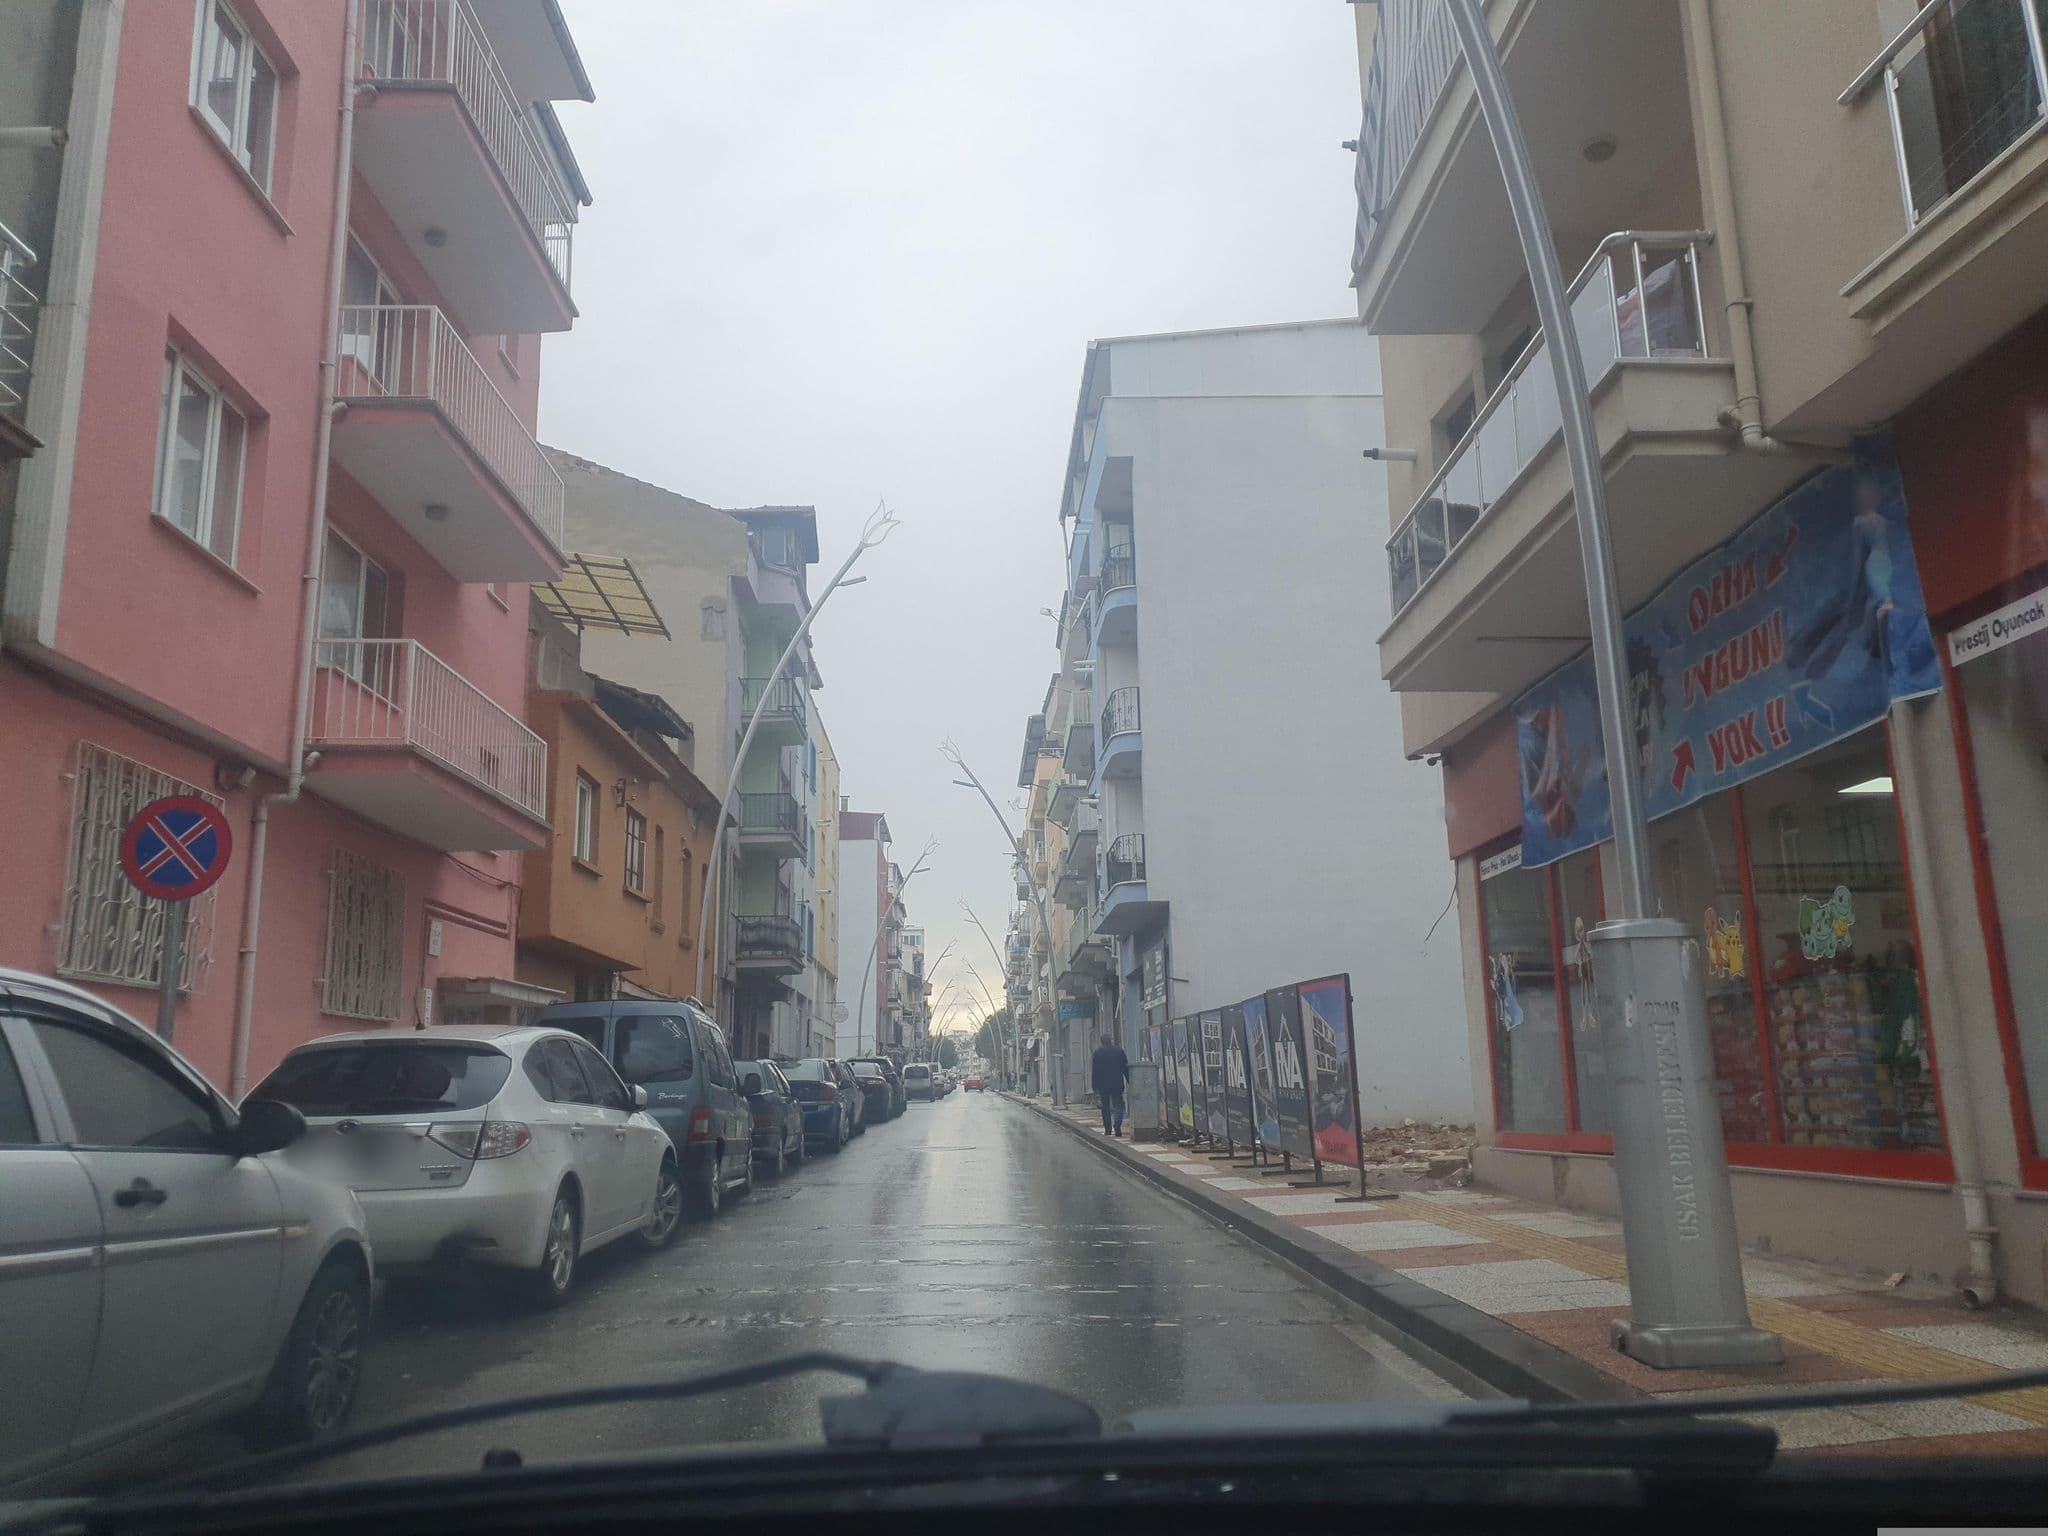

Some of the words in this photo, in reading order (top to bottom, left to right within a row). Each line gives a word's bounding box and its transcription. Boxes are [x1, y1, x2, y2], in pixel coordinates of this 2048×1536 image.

[1953, 623, 1990, 656] Prestij
[1992, 600, 2045, 640] Oyuncak
[1705, 709, 1767, 776] YOK
